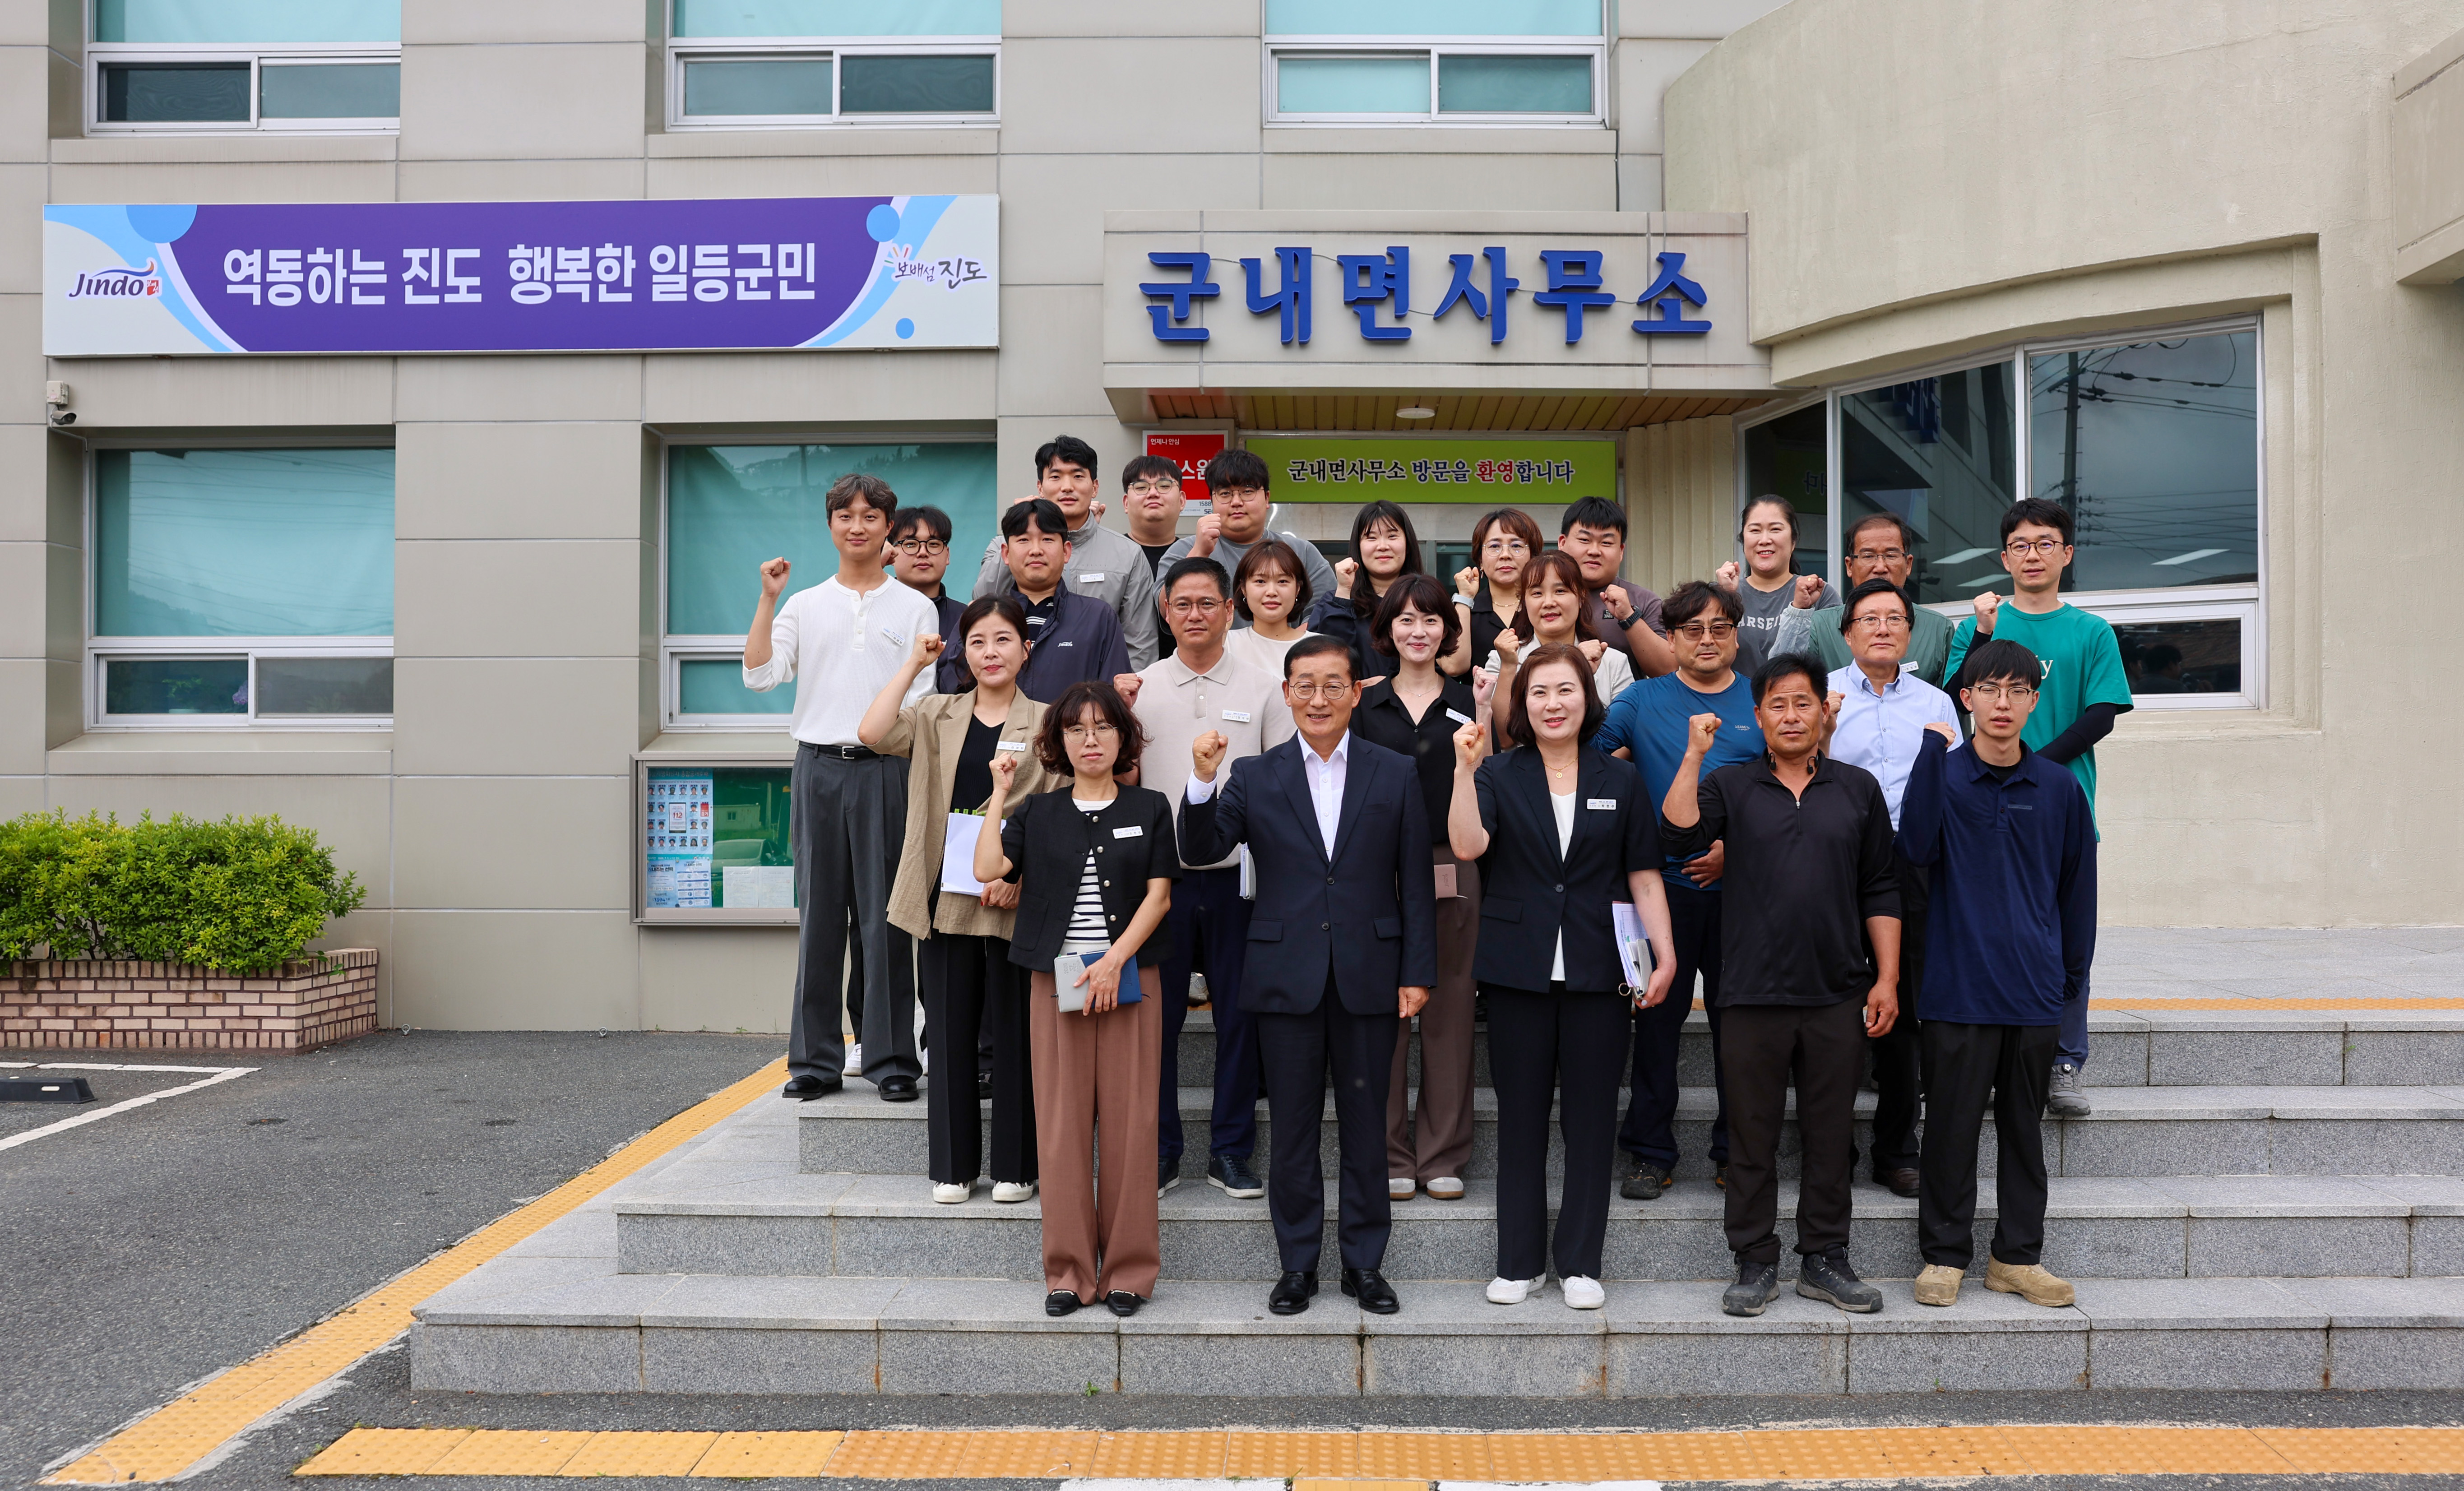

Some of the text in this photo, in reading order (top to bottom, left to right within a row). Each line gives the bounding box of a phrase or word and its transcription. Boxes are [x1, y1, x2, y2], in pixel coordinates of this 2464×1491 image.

[69, 273, 144, 297] Jindo
[224, 243, 815, 306] 역동하는 진도 행복한 일등군민
[895, 258, 987, 289] 보배섬 진도
[1139, 246, 1713, 343] 군내면사무소
[1173, 459, 1212, 480] 스원
[1288, 459, 1575, 484] 군내면사무소 방문을 환영합니다
[2036, 655, 2053, 680] y
